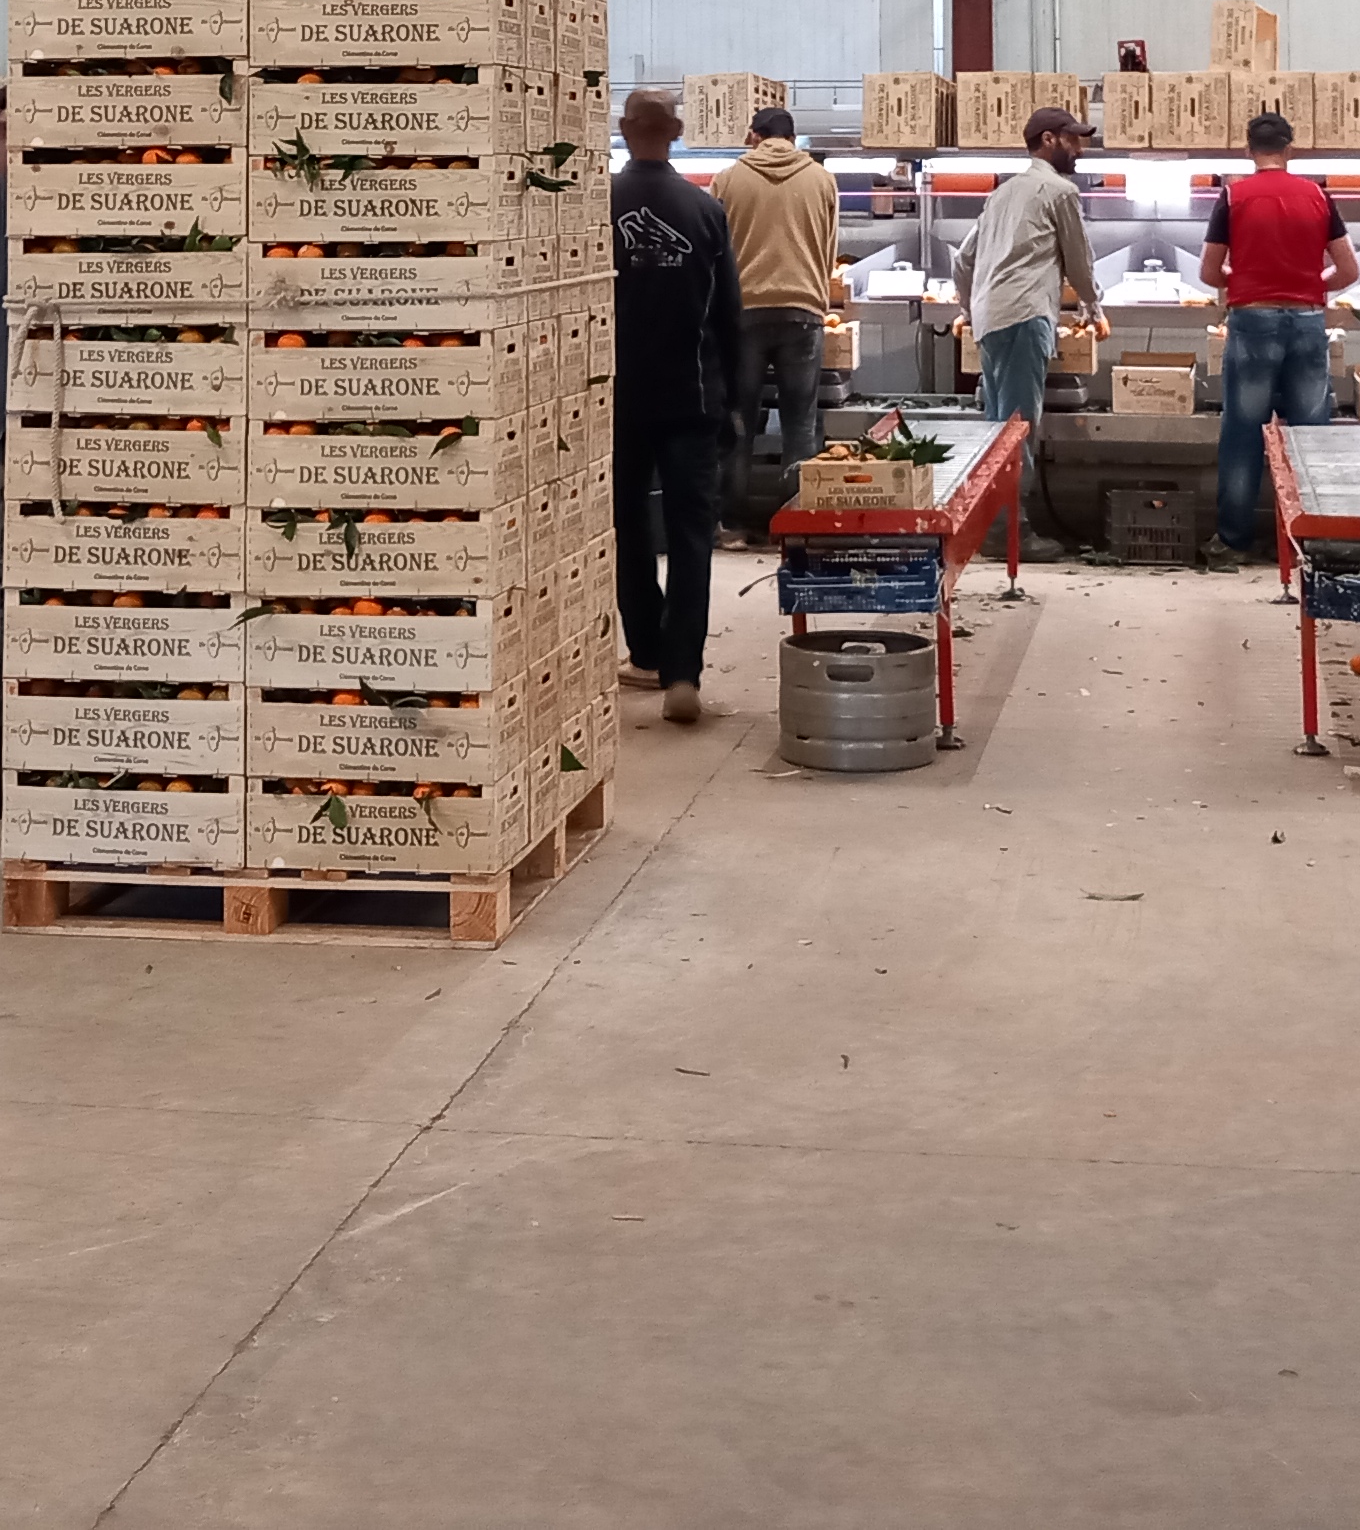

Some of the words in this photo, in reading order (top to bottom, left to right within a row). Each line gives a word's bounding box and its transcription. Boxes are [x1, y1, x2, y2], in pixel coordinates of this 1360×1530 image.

[322, 3, 348, 16] LES
[352, 3, 418, 16] VERGERS
[57, 17, 85, 35] DE
[90, 17, 193, 35] SUARONE
[301, 24, 329, 42] DE
[335, 24, 440, 42] SUARONE
[78, 85, 103, 97] LES
[106, 85, 171, 97] VERGERS
[322, 92, 348, 104] LES
[351, 92, 417, 104] VERGERS
[57, 105, 85, 123] DE
[90, 105, 193, 123] SUARONE
[300, 113, 328, 130] DE
[334, 113, 440, 130] SUARONE
[57, 193, 85, 211] DE
[90, 193, 193, 211] SUARONE
[299, 199, 328, 217] DE
[333, 199, 439, 217] SUARONE
[79, 261, 104, 273] LES
[107, 261, 171, 273] VERGERS
[57, 282, 85, 299] DE
[90, 282, 193, 299] SUARONE
[321, 358, 347, 370] LES
[350, 358, 417, 370] VERGERS
[91, 370, 194, 390] SUARONE
[300, 378, 328, 396] DE
[334, 378, 440, 396] SUARONE
[77, 439, 101, 452] LES
[105, 439, 169, 452] VERGERS
[321, 445, 347, 458] LES
[350, 445, 417, 458] VERGERS
[88, 459, 190, 479] SUARONE
[299, 466, 328, 485] DE
[333, 466, 439, 485] SUARONE
[54, 546, 81, 566] DE
[87, 546, 191, 566] SUARONE
[298, 551, 327, 570] DE
[332, 552, 439, 572] SUARONE
[75, 616, 100, 630] LES
[103, 616, 169, 630] VERGERS
[320, 625, 345, 640] LES
[349, 625, 416, 640] VERGERS
[53, 637, 84, 656] DE
[87, 637, 191, 656] SUARONE
[298, 645, 326, 667] DE
[332, 645, 437, 667] SUARONE
[320, 715, 346, 729] LES
[349, 715, 417, 729] VERGERS
[53, 728, 81, 749] DE
[87, 728, 190, 749] SUARONE
[298, 734, 327, 755] DE
[332, 737, 438, 757] SUARONE
[74, 799, 99, 815] LES
[103, 799, 168, 815] VERGERS
[53, 819, 80, 842] DE
[85, 819, 190, 842] SUARONE
[298, 825, 326, 845] DE
[331, 826, 438, 847] SUARONE
